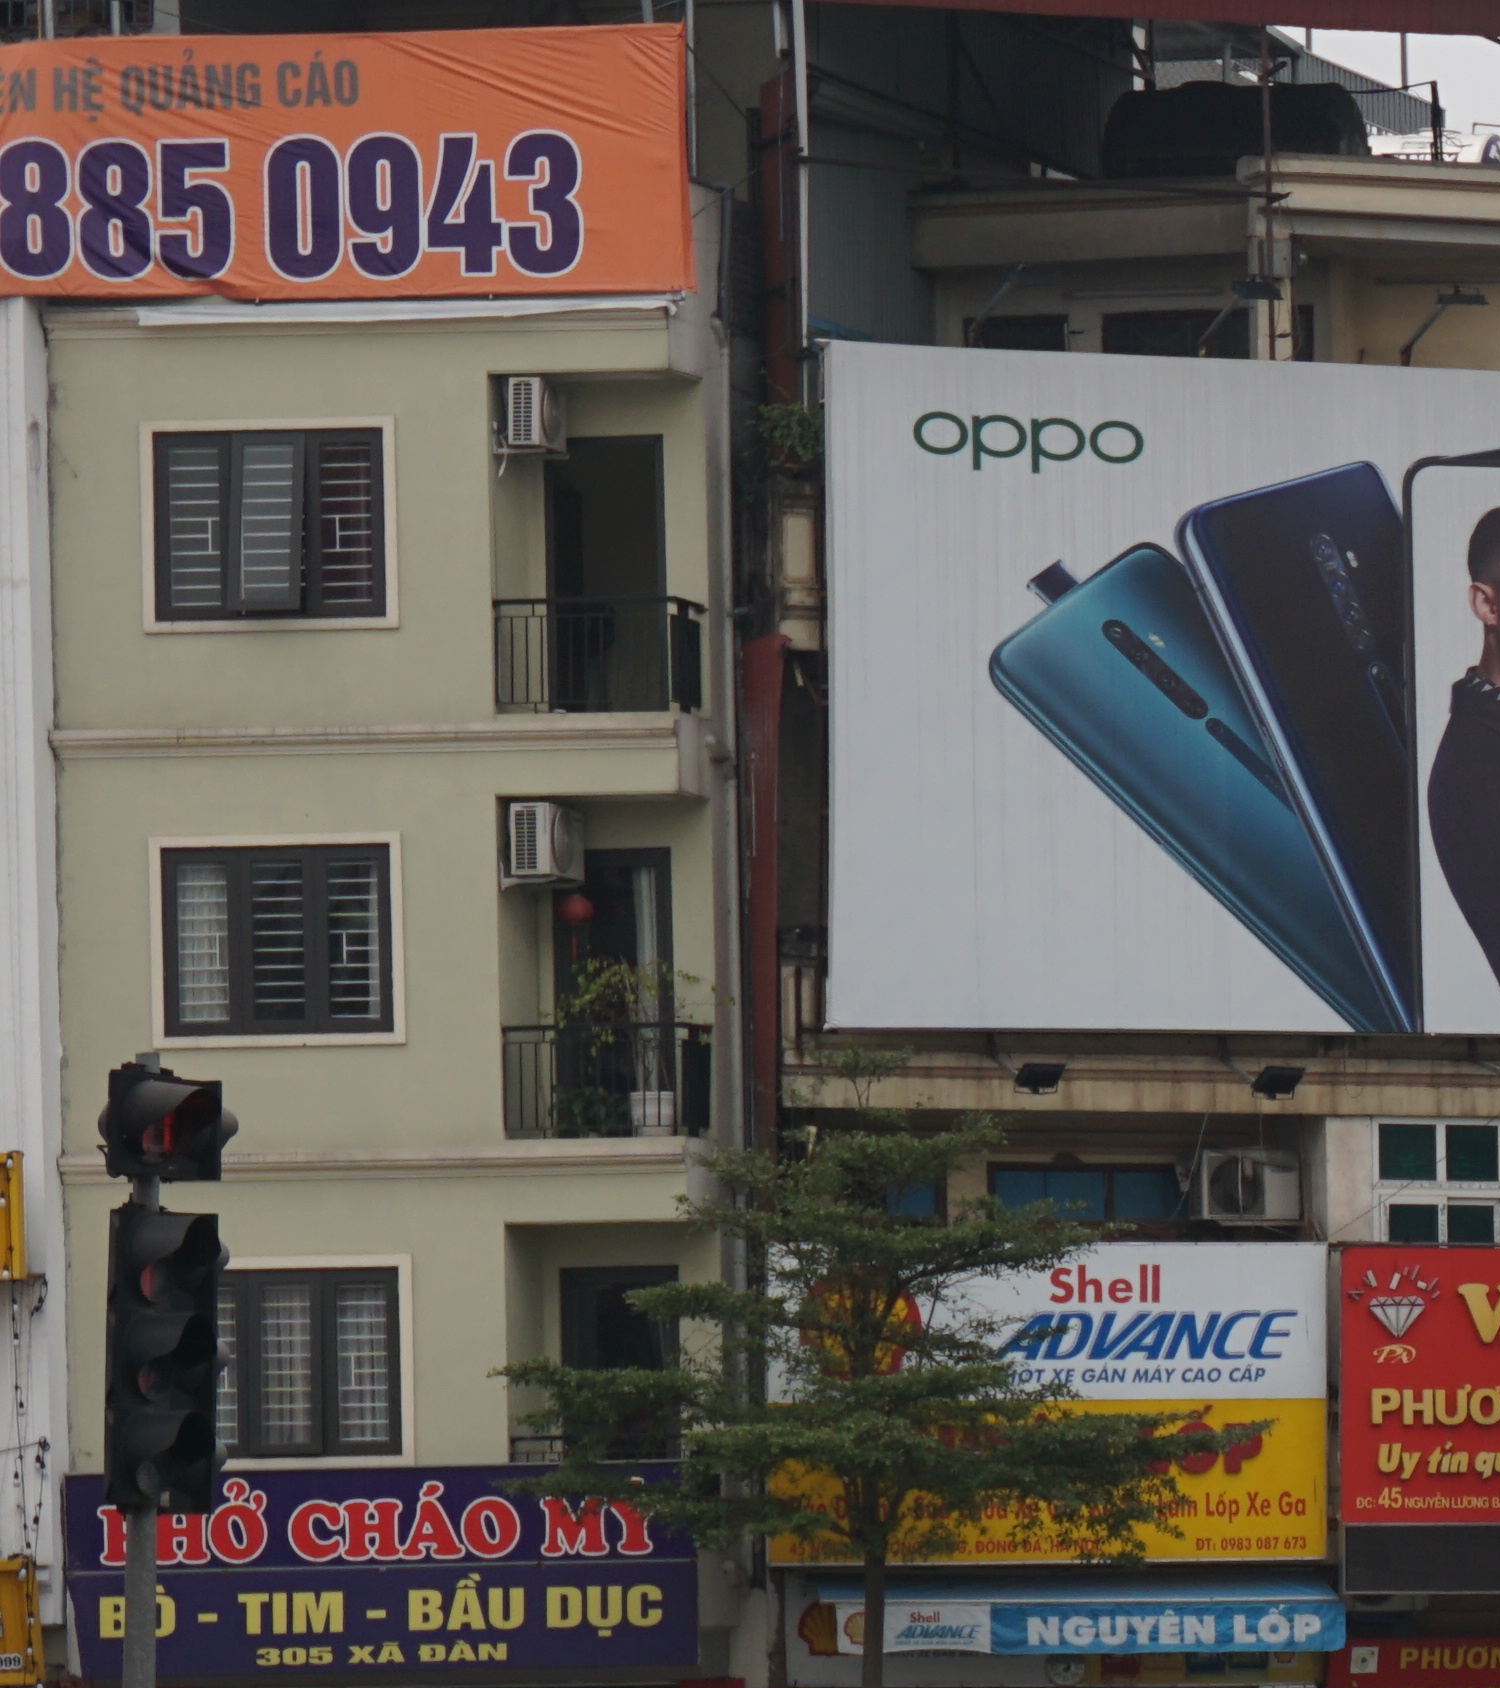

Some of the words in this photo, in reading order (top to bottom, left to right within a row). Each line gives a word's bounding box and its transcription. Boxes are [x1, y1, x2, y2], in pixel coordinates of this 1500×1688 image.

[53, 57, 105, 122] HỆ
[120, 48, 262, 117] QUẢNG
[277, 51, 359, 107] CÁO
[263, 128, 584, 282] 0943
[913, 410, 1144, 473] oppo
[1050, 1264, 1160, 1303] Shell
[1001, 1309, 1298, 1361] ADVANCE
[1050, 1367, 1075, 1385] XE
[1133, 1365, 1175, 1384] MÁY
[1181, 1367, 1221, 1384] CAO
[1228, 1363, 1265, 1383] CẤP
[1377, 1443, 1420, 1480] Uy
[1426, 1441, 1469, 1474] tín
[1204, 1491, 1240, 1524] Lốp
[1246, 1492, 1272, 1517] Xe
[1278, 1491, 1306, 1517] Ga
[1378, 1487, 1402, 1509] 45
[288, 1481, 522, 1563] CHÁO
[1220, 1537, 1251, 1551] 0983
[1256, 1537, 1279, 1551] 087
[1283, 1536, 1307, 1551] 673
[237, 1591, 345, 1635] TIM
[408, 1573, 525, 1632] BẦU
[546, 1584, 664, 1638] DỤC
[895, 1624, 981, 1641] ADVANCE
[909, 1610, 941, 1624] Shell
[1027, 1609, 1216, 1647] NGUYÊN
[1234, 1604, 1322, 1644] LỐP
[255, 1646, 333, 1668] 305
[347, 1640, 406, 1665] XÃ
[418, 1639, 508, 1664] ĐÀN
